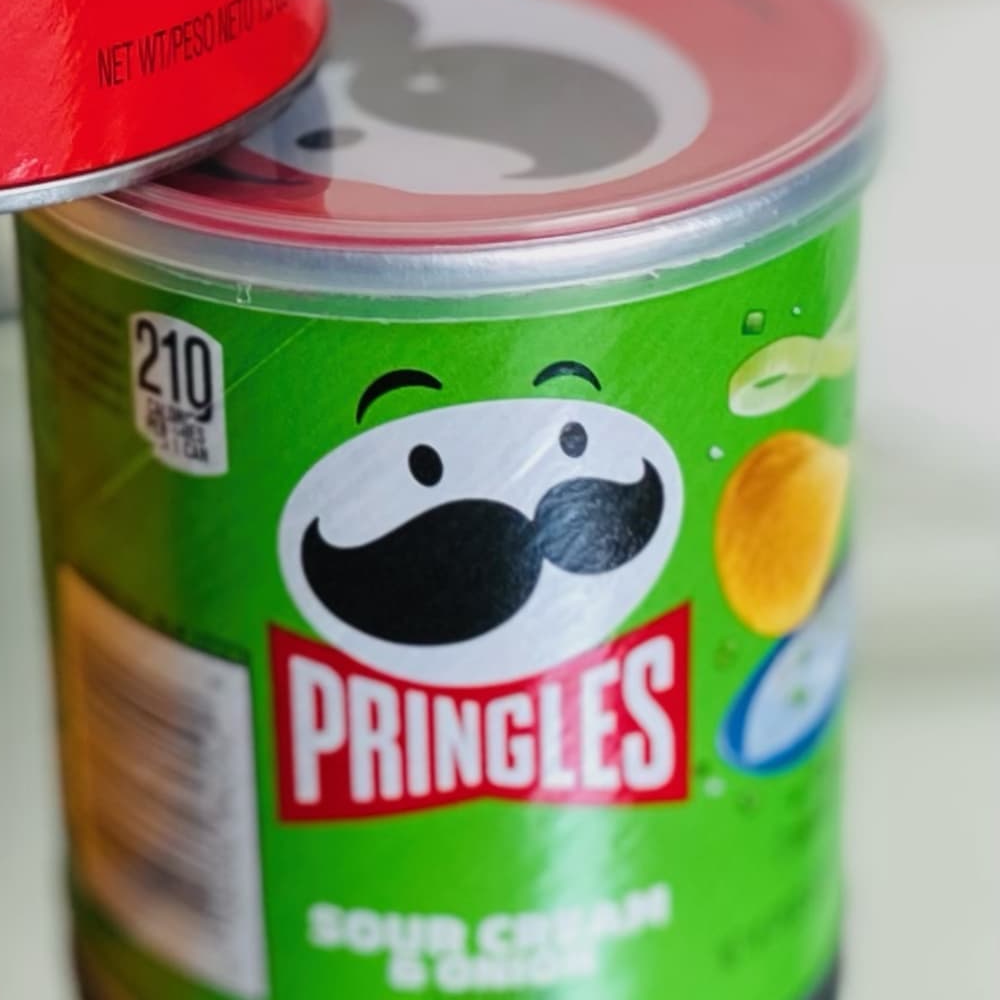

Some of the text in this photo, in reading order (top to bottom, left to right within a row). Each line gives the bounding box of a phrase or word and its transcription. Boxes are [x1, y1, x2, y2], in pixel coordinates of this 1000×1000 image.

[97, 41, 133, 88] NET
[136, 318, 213, 410] 210
[288, 634, 676, 806] PRINGLES
[306, 900, 468, 956] SOUR
